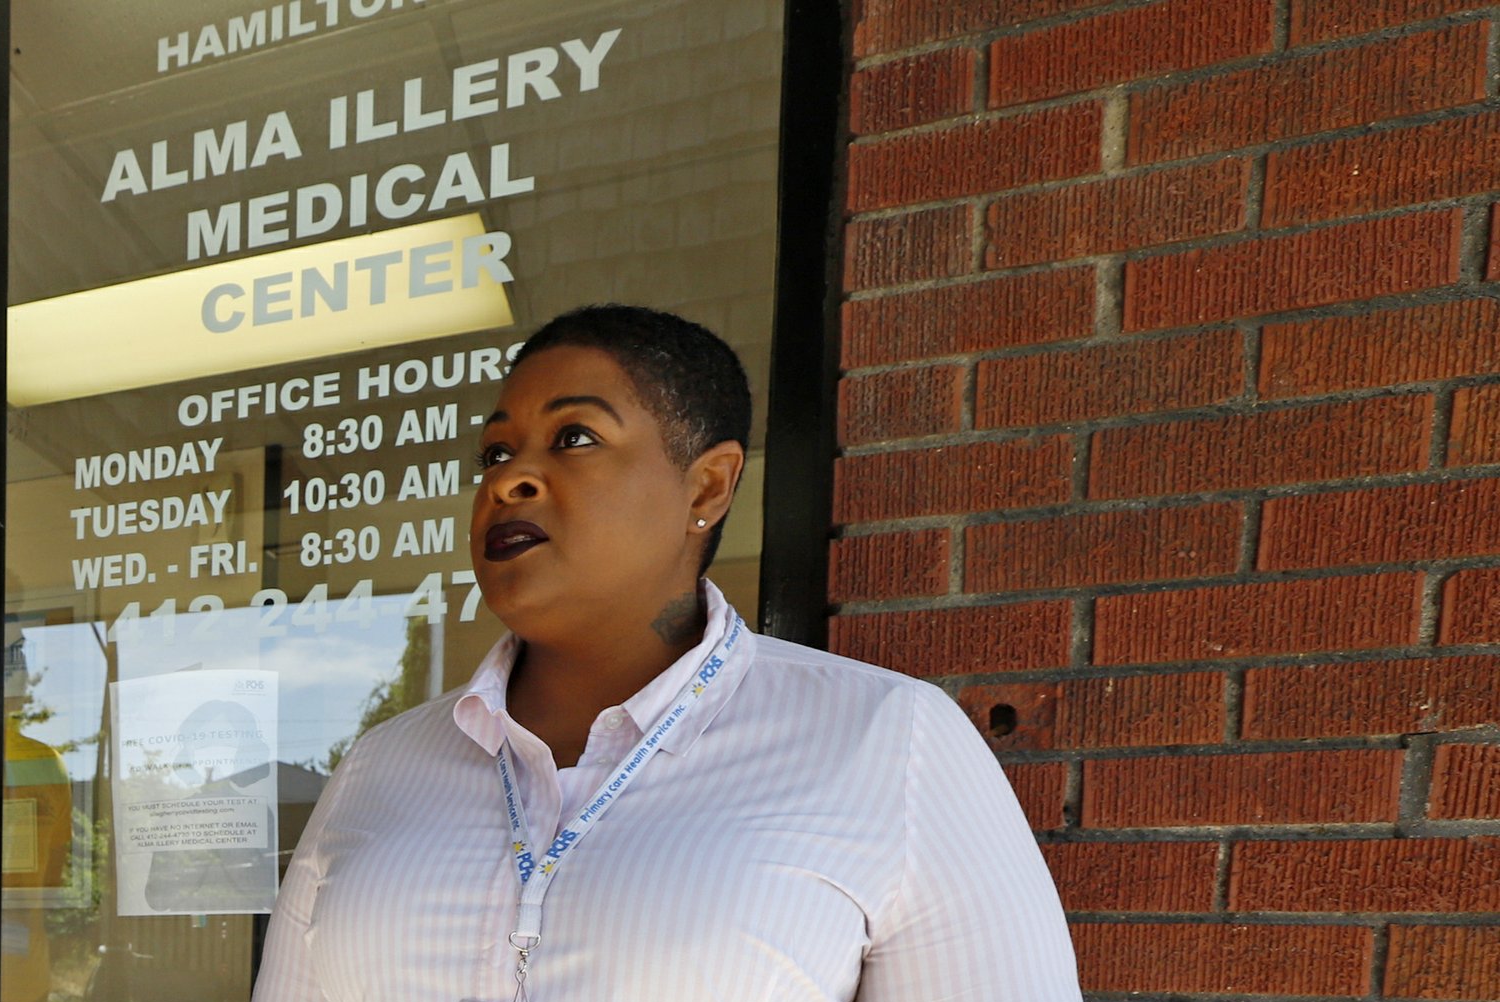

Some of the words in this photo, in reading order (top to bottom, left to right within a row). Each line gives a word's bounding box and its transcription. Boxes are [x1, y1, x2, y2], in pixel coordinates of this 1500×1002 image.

[157, 0, 426, 73] HAMILTO
[100, 110, 302, 203] ALMA
[329, 28, 623, 150] ILLERY
[186, 143, 535, 261] MEDICAL
[201, 230, 515, 334] CENTER
[178, 372, 340, 427] OFFICE
[74, 437, 223, 490] MONDAY
[302, 415, 383, 459] 8:30
[395, 403, 458, 447] AM
[70, 489, 232, 540] TUESDAY
[283, 470, 385, 515] 10:30
[397, 460, 460, 502] AM
[72, 552, 156, 590] WED.
[189, 540, 258, 578] FRI.
[300, 525, 380, 567] 8:30
[393, 517, 455, 558] AM
[699, 654, 725, 684] PCHS
[148, 732, 206, 745] COVID-19
[211, 729, 264, 740] TESTING
[162, 801, 200, 809] SCHEDULE
[546, 829, 579, 859] PCHS
[580, 793, 613, 823] Primary
[608, 772, 628, 792] Care
[626, 746, 649, 774] Health
[646, 716, 676, 748] Services
[674, 704, 688, 719] Inc.
